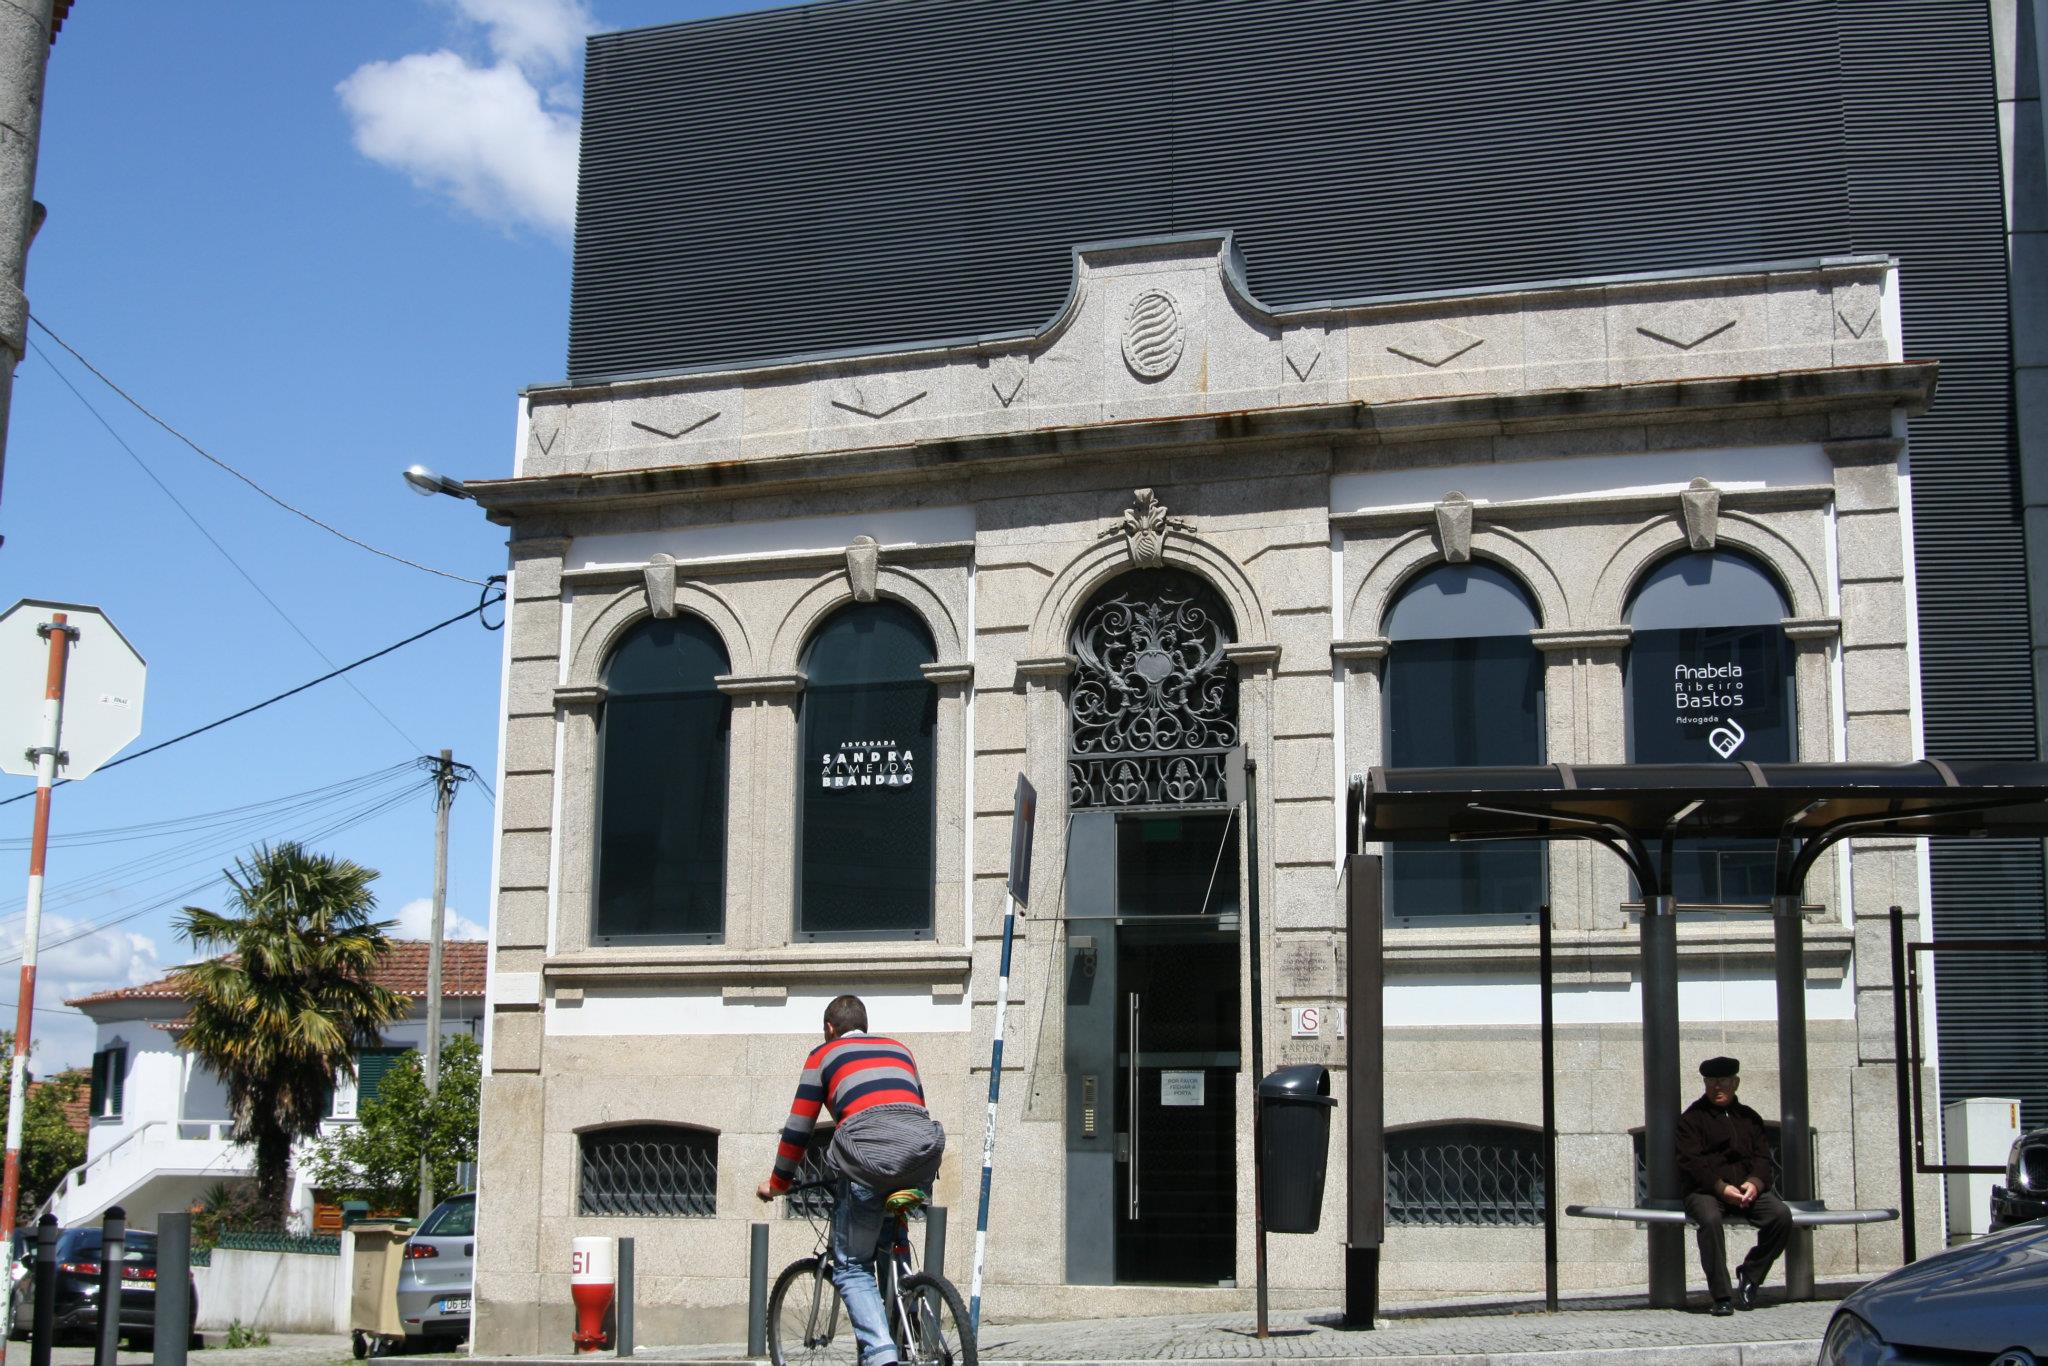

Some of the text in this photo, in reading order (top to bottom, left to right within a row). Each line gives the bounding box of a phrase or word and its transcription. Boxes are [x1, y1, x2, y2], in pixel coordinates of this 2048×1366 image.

[1675, 662, 1742, 679] Anabela
[1675, 681, 1743, 692] Ribeiro
[1676, 692, 1744, 708] Bastos
[1676, 716, 1719, 725] Advogada
[840, 740, 896, 748] ADVOGADA
[822, 750, 913, 765] SANDRA
[821, 762, 913, 775] ALMEIDA
